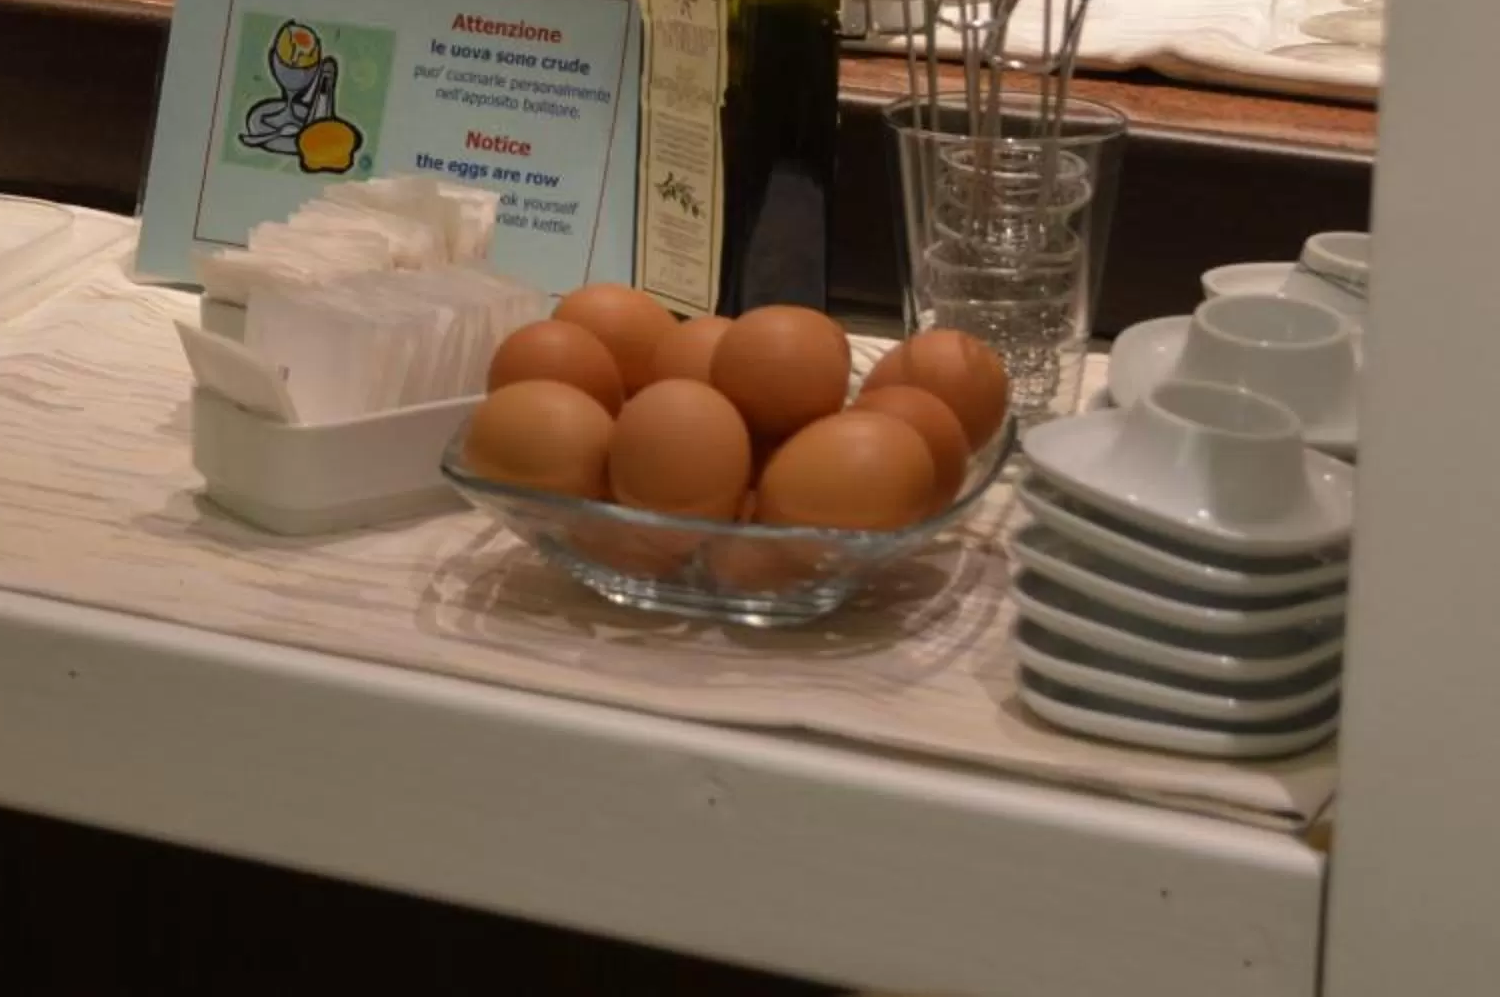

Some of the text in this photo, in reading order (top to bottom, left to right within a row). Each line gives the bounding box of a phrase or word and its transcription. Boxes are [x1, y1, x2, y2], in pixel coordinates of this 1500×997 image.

[451, 12, 562, 43] Attenzione
[431, 39, 591, 75] le uova sono crude
[436, 87, 519, 110] nell'apposito
[446, 69, 507, 88] cucinarle
[510, 76, 611, 103] personalmente
[465, 130, 532, 156] Notice
[416, 153, 561, 188] the eggs are row
[524, 196, 580, 216] yourself
